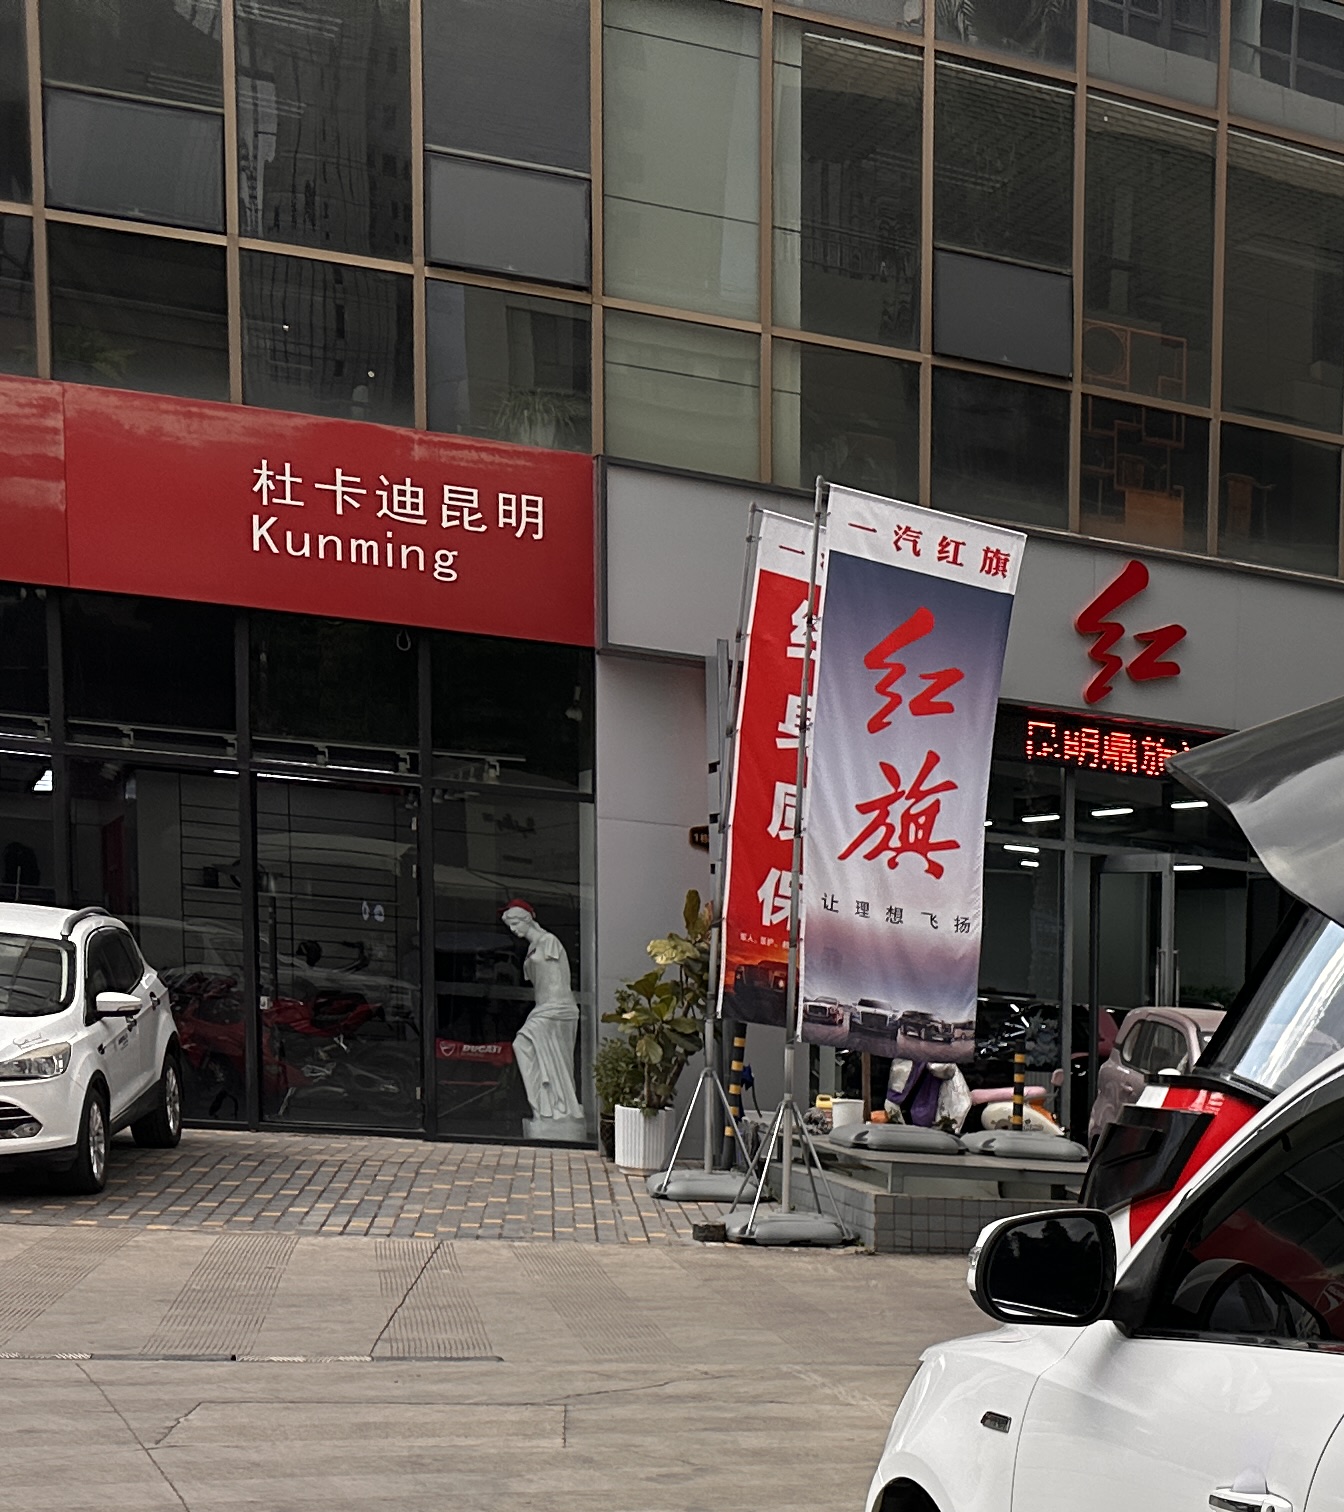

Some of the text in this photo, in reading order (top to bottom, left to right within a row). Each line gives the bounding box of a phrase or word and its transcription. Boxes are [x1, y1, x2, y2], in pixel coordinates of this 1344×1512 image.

[252, 459, 544, 541] 杜卡迪昆明
[252, 514, 459, 582] Kunming
[848, 523, 1011, 579] 一汽红旗
[1074, 559, 1188, 704] 红
[838, 606, 965, 881] 红旗
[821, 892, 971, 934] 让理想飞扬
[462, 1044, 502, 1054] DUCATI
